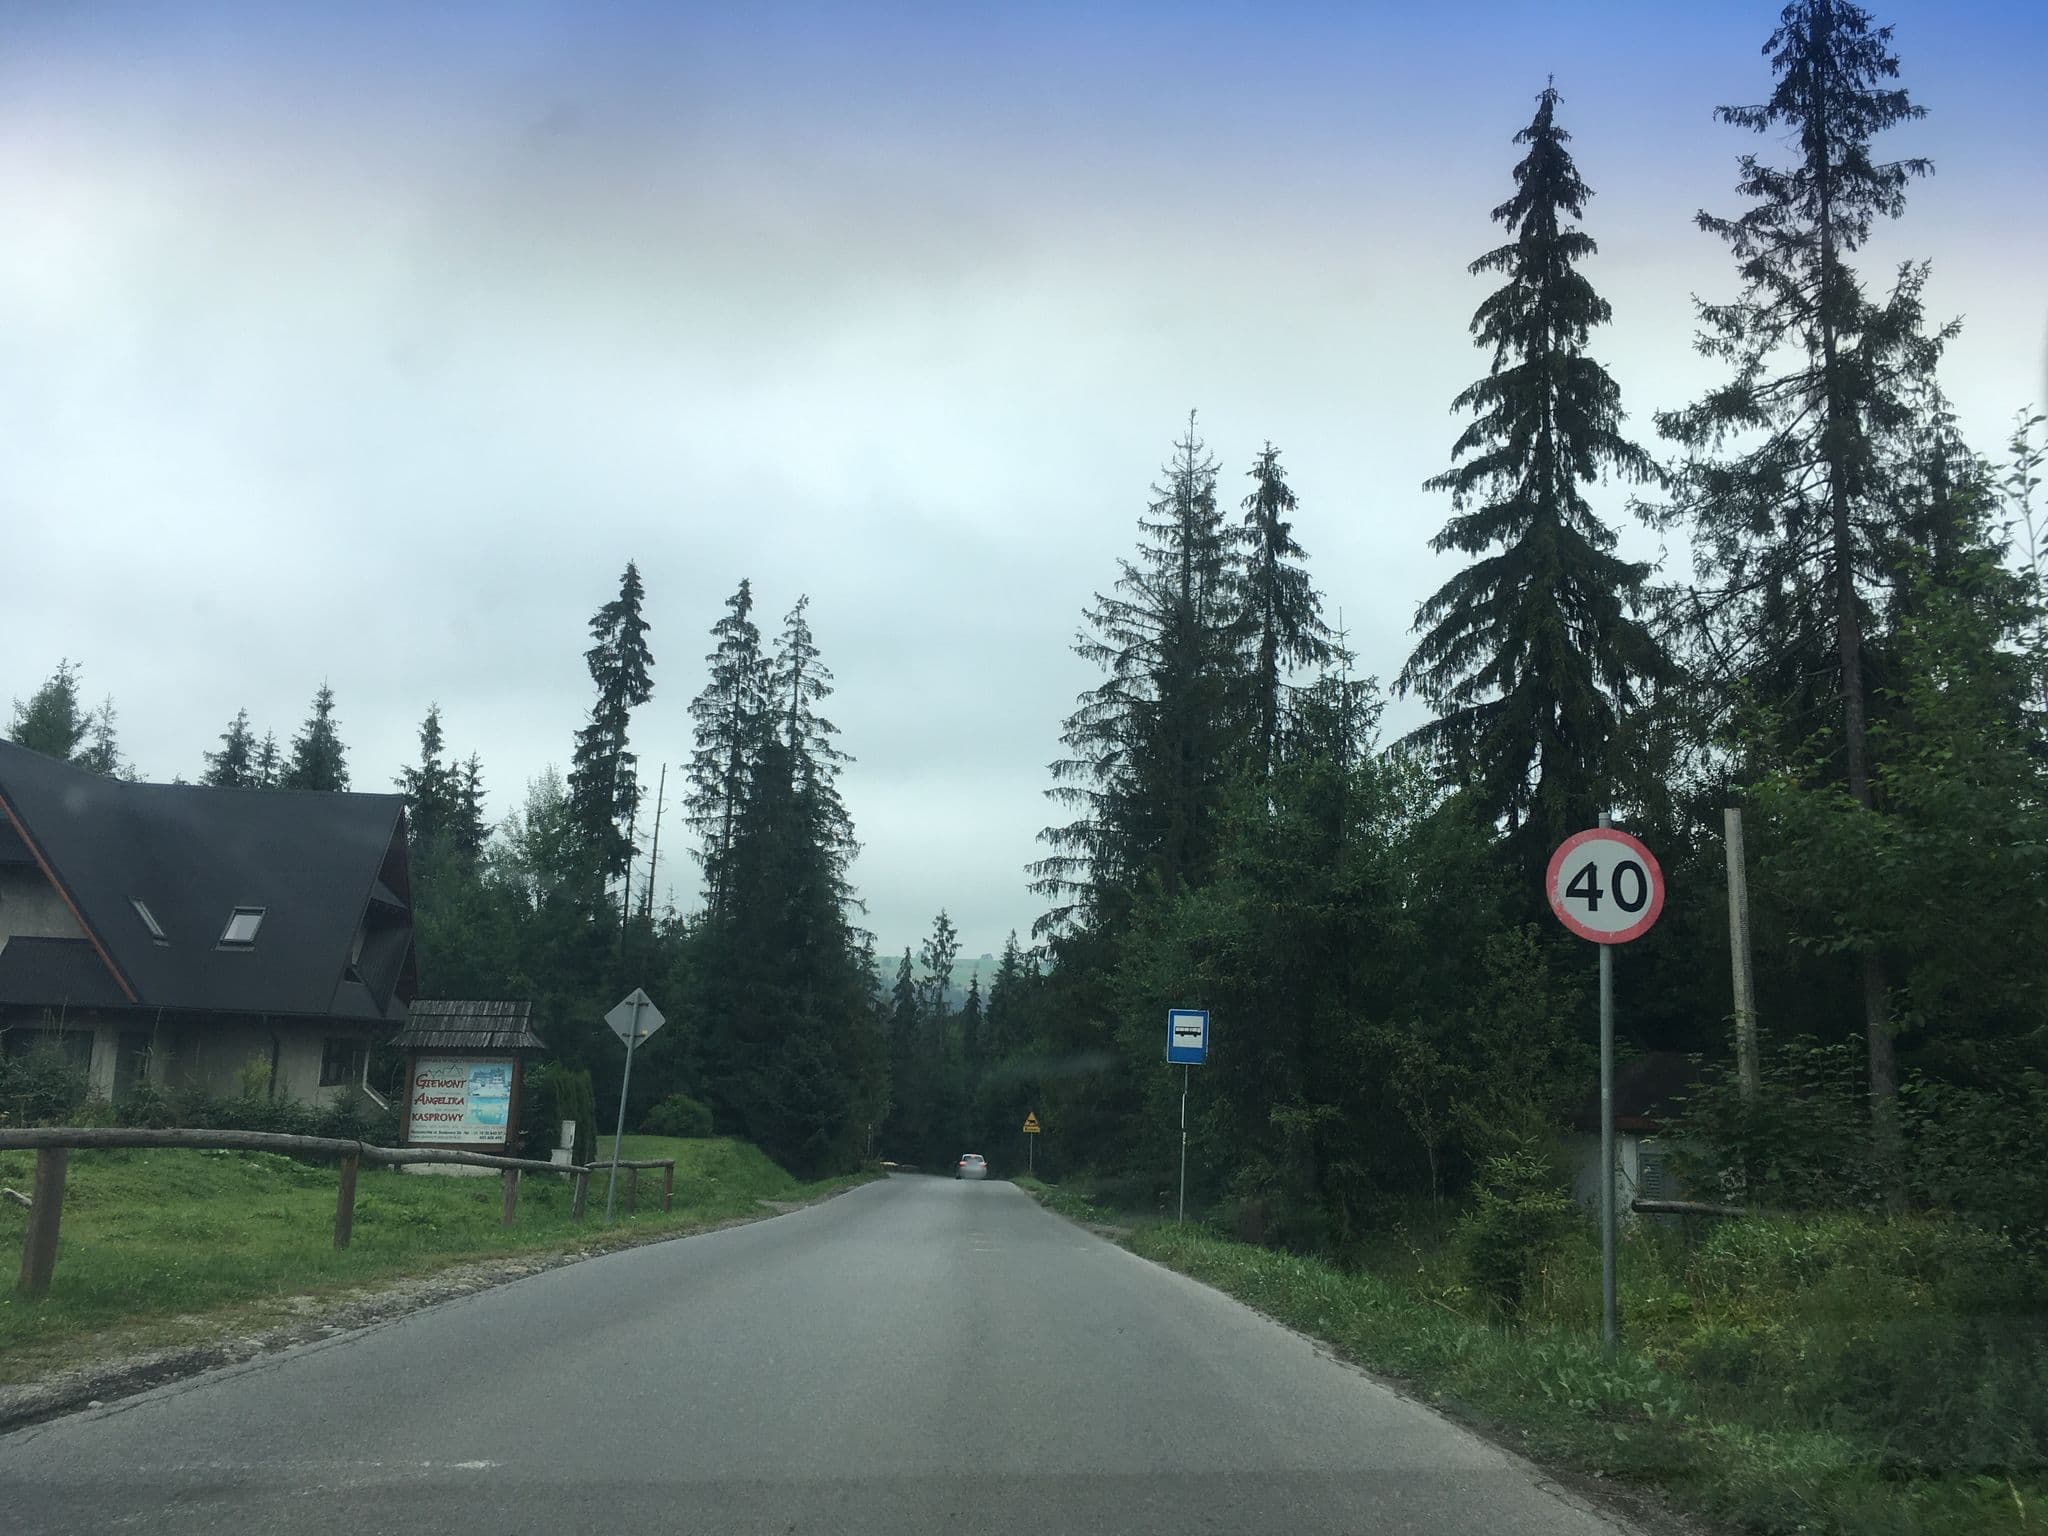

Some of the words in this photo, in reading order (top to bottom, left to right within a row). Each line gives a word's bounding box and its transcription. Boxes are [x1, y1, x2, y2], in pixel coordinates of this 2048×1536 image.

[1566, 860, 1648, 913] 40
[415, 1073, 467, 1089] GIEWONT
[414, 1092, 465, 1106] ANGELIKA
[411, 1113, 464, 1122] KASPROWY
